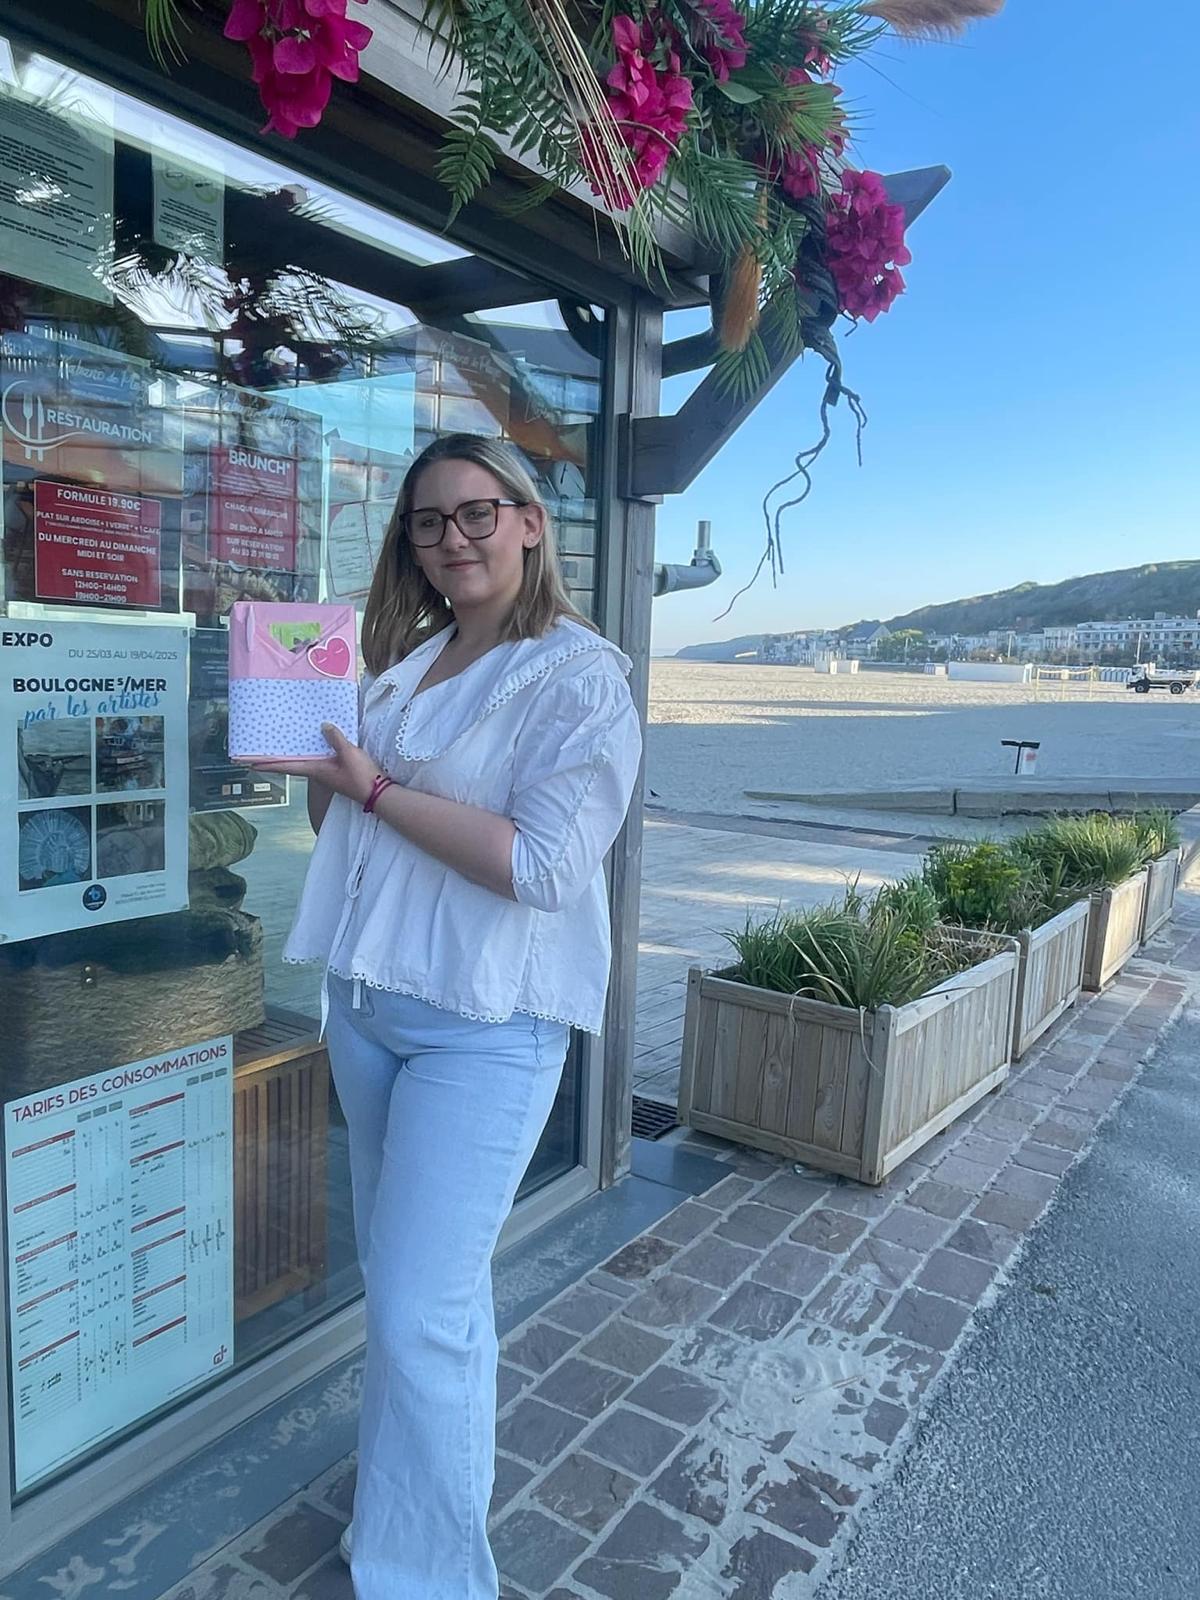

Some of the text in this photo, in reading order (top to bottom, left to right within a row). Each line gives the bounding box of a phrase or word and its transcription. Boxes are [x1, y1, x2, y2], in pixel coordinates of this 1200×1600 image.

[47, 409, 152, 443] RESTAURATION
[57, 489, 106, 506] FORMULE
[38, 532, 157, 555] DU MERCREDI AU DIMANCHE
[96, 551, 106, 559] ET
[107, 553, 124, 562] SOIR
[62, 568, 138, 583] SANS RESERVATION
[2, 631, 53, 648] EXPO
[68, 649, 83, 658] DU
[114, 649, 127, 659] AU
[13, 677, 115, 692] BOULOGNE
[24, 690, 161, 730] par les artistes
[12, 1093, 65, 1123] TARIFS
[69, 1084, 98, 1104] DES
[101, 1043, 227, 1093] CONSOMMATIONS
